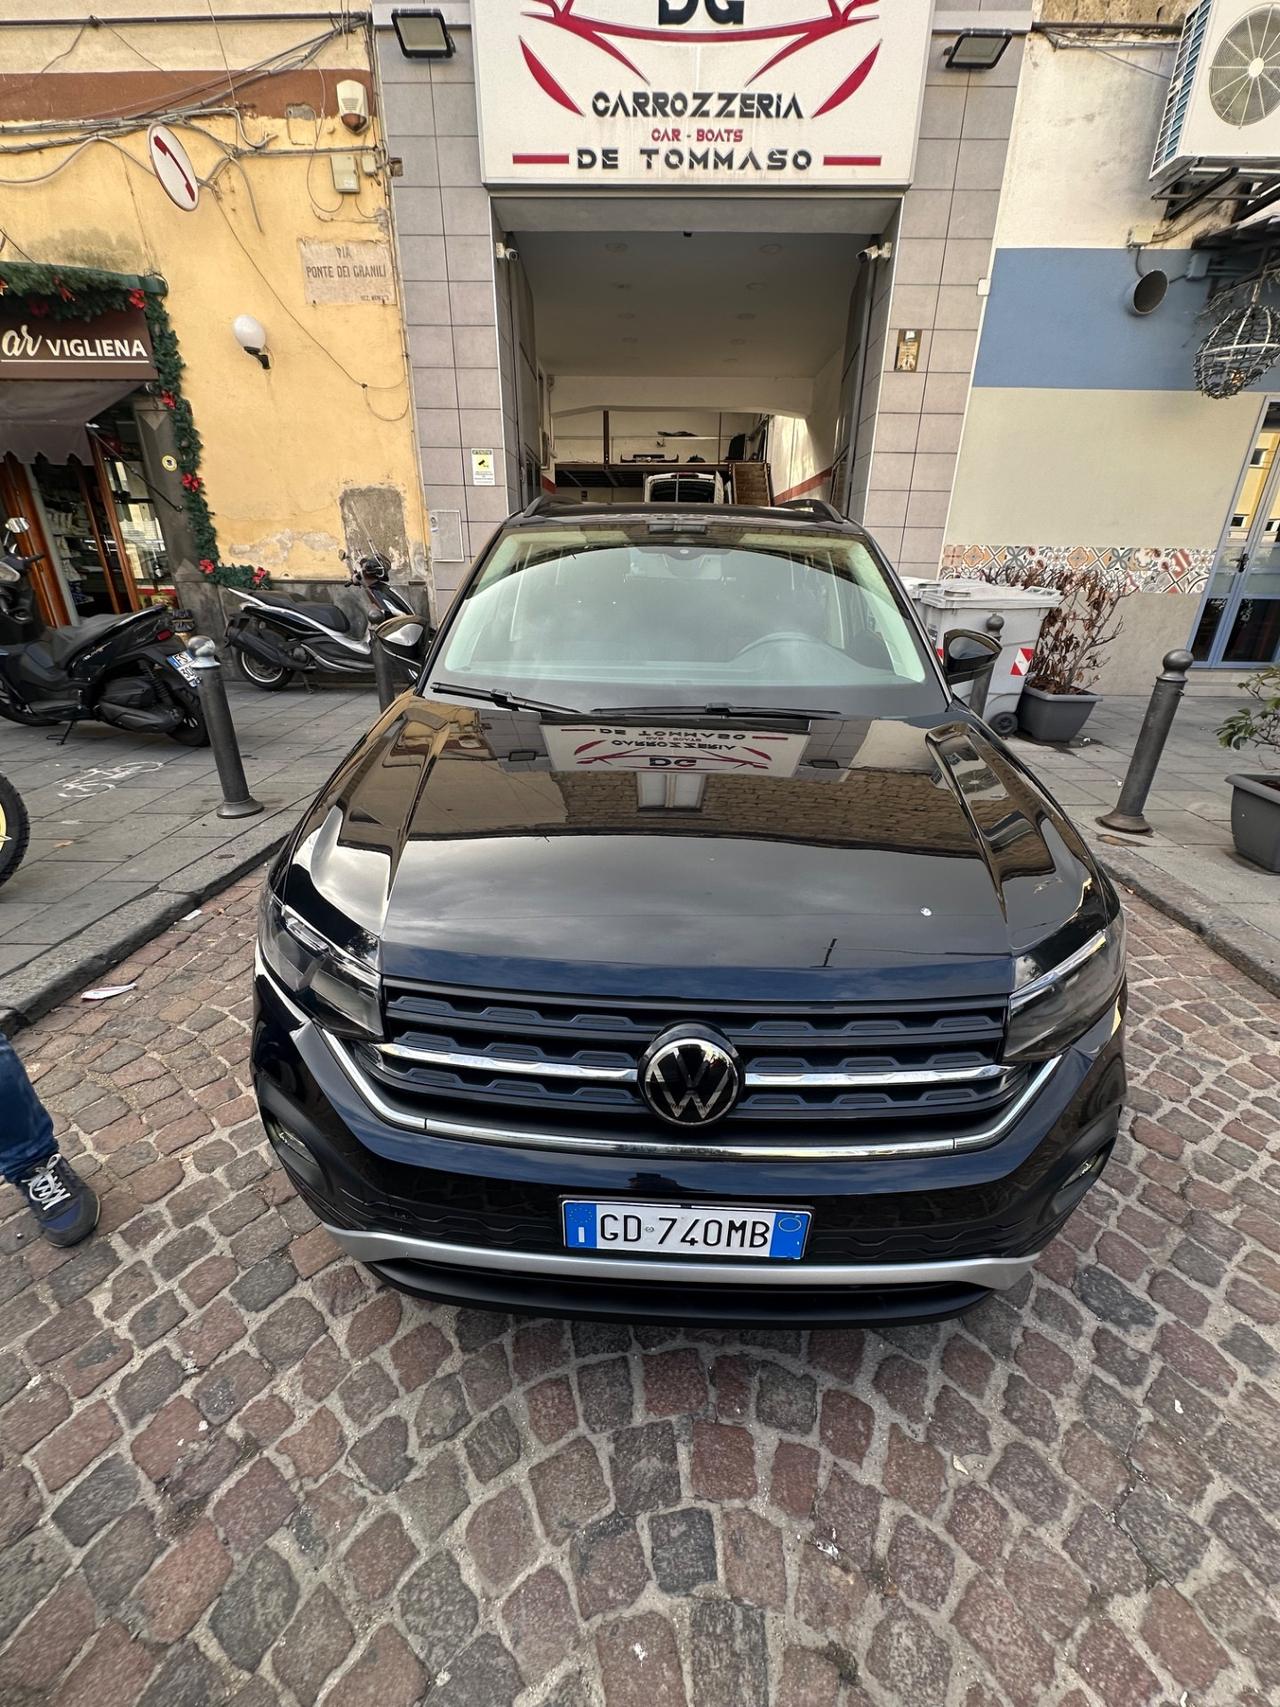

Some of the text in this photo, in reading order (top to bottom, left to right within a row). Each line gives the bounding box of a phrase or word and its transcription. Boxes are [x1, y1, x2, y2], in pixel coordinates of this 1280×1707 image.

[592, 90, 804, 119] CARROZZERIA
[651, 127, 681, 142] CAR
[696, 128, 743, 142] BOATS
[577, 148, 812, 171] DE TOMMASO
[306, 265, 334, 279] PONTE
[337, 265, 351, 278] DEI
[46, 339, 148, 357] VIGLIENA
[600, 1214, 642, 1242] GD
[657, 1217, 770, 1249] 740MB
